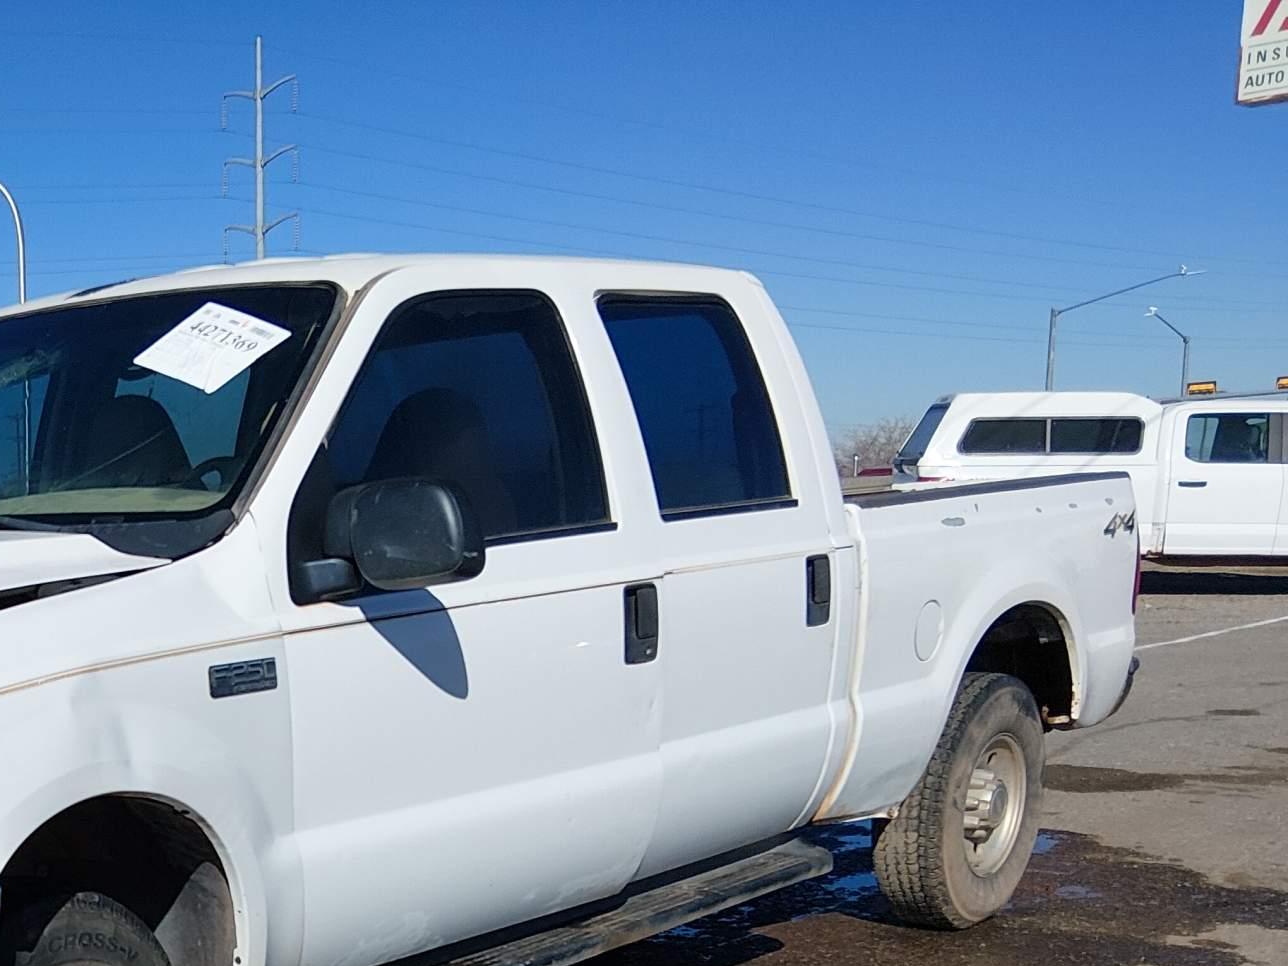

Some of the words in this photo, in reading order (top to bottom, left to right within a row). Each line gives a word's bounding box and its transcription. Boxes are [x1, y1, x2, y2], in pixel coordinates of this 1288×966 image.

[1247, 46, 1288, 65] INS
[1245, 70, 1285, 89] AUTO
[189, 321, 259, 353] 44271369
